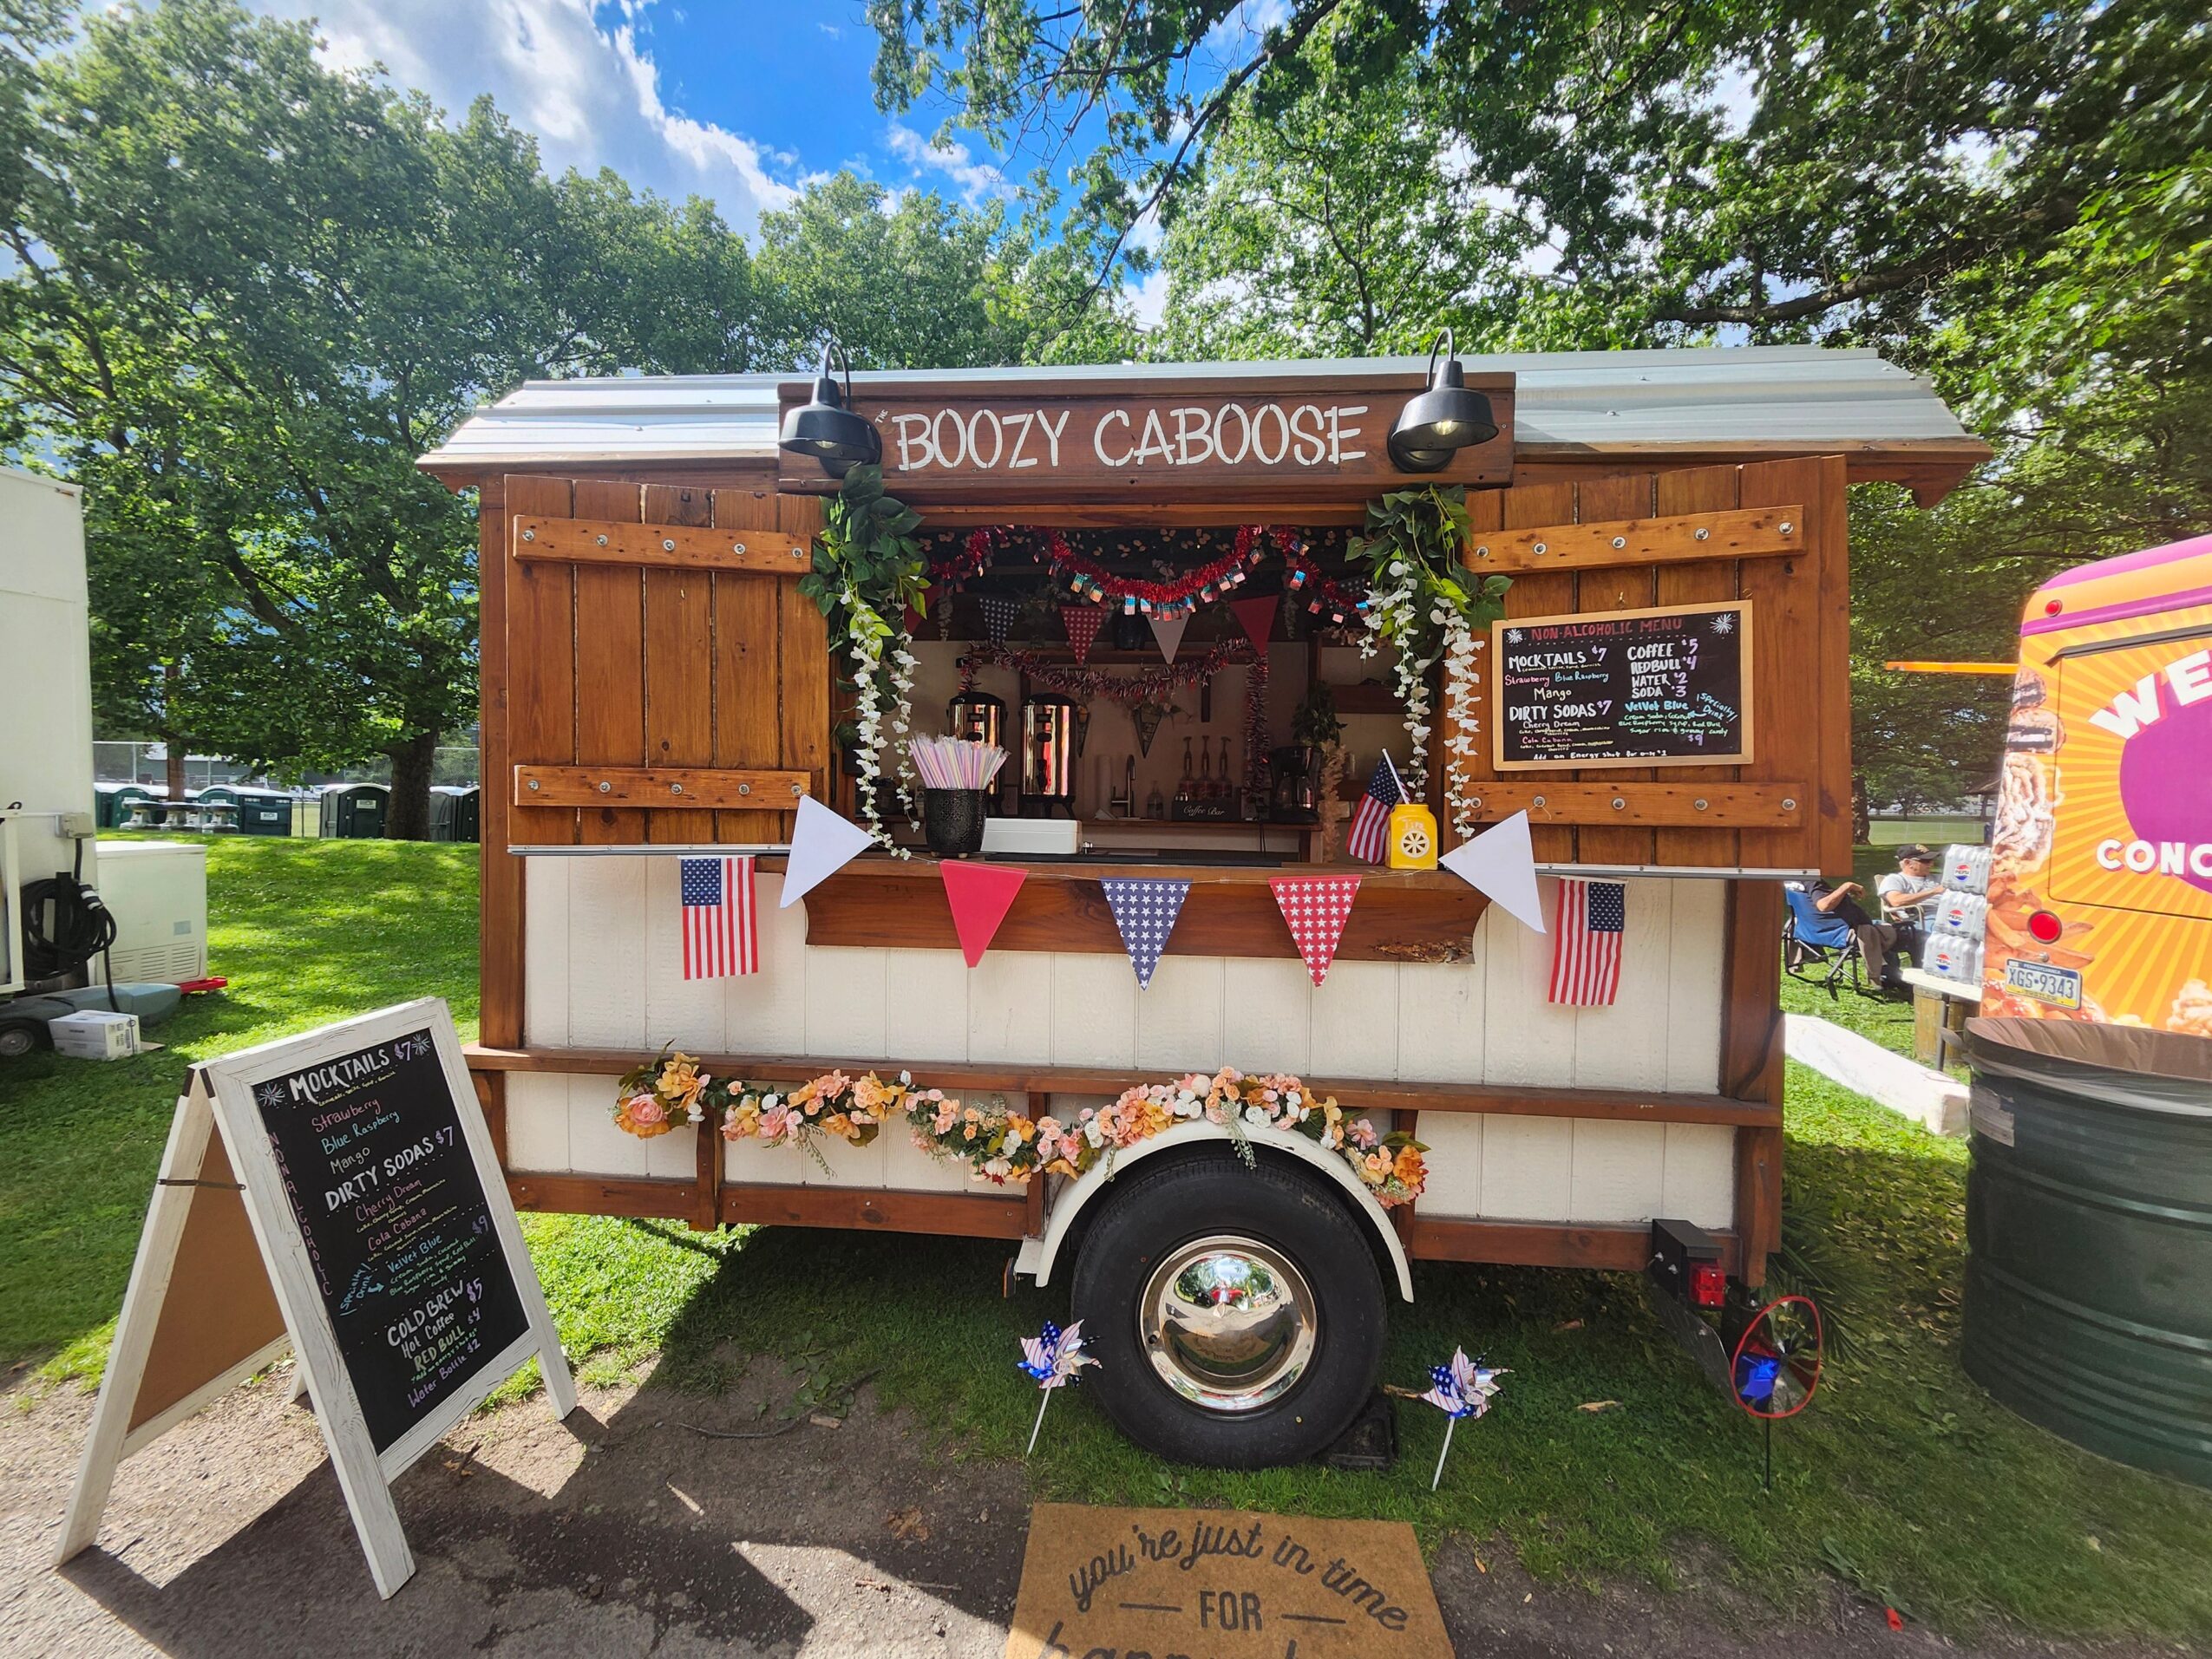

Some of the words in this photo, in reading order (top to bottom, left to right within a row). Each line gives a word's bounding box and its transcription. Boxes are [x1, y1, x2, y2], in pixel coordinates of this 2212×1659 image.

[891, 408, 1070, 474] BOOZY
[1092, 402, 1369, 467] CABOOSE
[1639, 617, 1683, 633] MENU
[1508, 650, 1587, 673] MOCKTAILS
[1631, 658, 1682, 676] REDBULL
[1504, 674, 1550, 688] Strawberry
[1554, 671, 1574, 683] Blue
[1574, 670, 1609, 683] Raspberry
[1632, 673, 1672, 689] WATER
[1534, 687, 1572, 702] Mango
[1631, 686, 1664, 699] SODA
[1509, 705, 1548, 723] DIRTY
[1553, 702, 1597, 719] SODAS
[1663, 700, 1690, 710] Blue
[1702, 704, 1724, 721] Drink
[1522, 720, 1550, 730] Cherry
[1554, 720, 1580, 728] Dream
[1522, 735, 1540, 745] Cola
[1687, 734, 1704, 746] $9
[1569, 752, 1599, 761] Energy
[1182, 804, 1206, 817] Coffee
[1207, 807, 1226, 816] Bar
[1935, 957, 1951, 966] PEPSI
[289, 1048, 390, 1105] MOCKTAILS
[394, 1041, 411, 1061] $7
[311, 1098, 382, 1133] Strawberry
[321, 1133, 351, 1155] Blue
[351, 1110, 400, 1138] Raspberry
[324, 1165, 378, 1212] DIRTY
[383, 1136, 435, 1178] SODAS
[435, 1126, 454, 1147] $7
[330, 1146, 371, 1175] Mango
[354, 1192, 396, 1223] Cherry
[393, 1179, 423, 1199] Dream
[367, 1231, 391, 1251] Cola
[392, 1206, 428, 1235] Cabana
[471, 1215, 489, 1236] $9
[419, 1235, 443, 1255] Blue
[356, 1274, 373, 1300] Drink
[387, 1309, 426, 1347] COLD
[425, 1279, 464, 1319] BREW
[466, 1277, 483, 1303] $5
[401, 1336, 422, 1360] Hot
[424, 1311, 455, 1341] Coffee
[413, 1346, 438, 1372] RED
[437, 1324, 466, 1353] BULL
[408, 1379, 437, 1408] Water
[438, 1354, 468, 1381] Bottle
[467, 1338, 481, 1355] $2
[1068, 1524, 1183, 1614] you're
[1178, 1520, 1264, 1571] just
[1272, 1534, 1315, 1576] in
[1320, 1558, 1410, 1632] time
[1198, 1590, 1263, 1631] FOR
